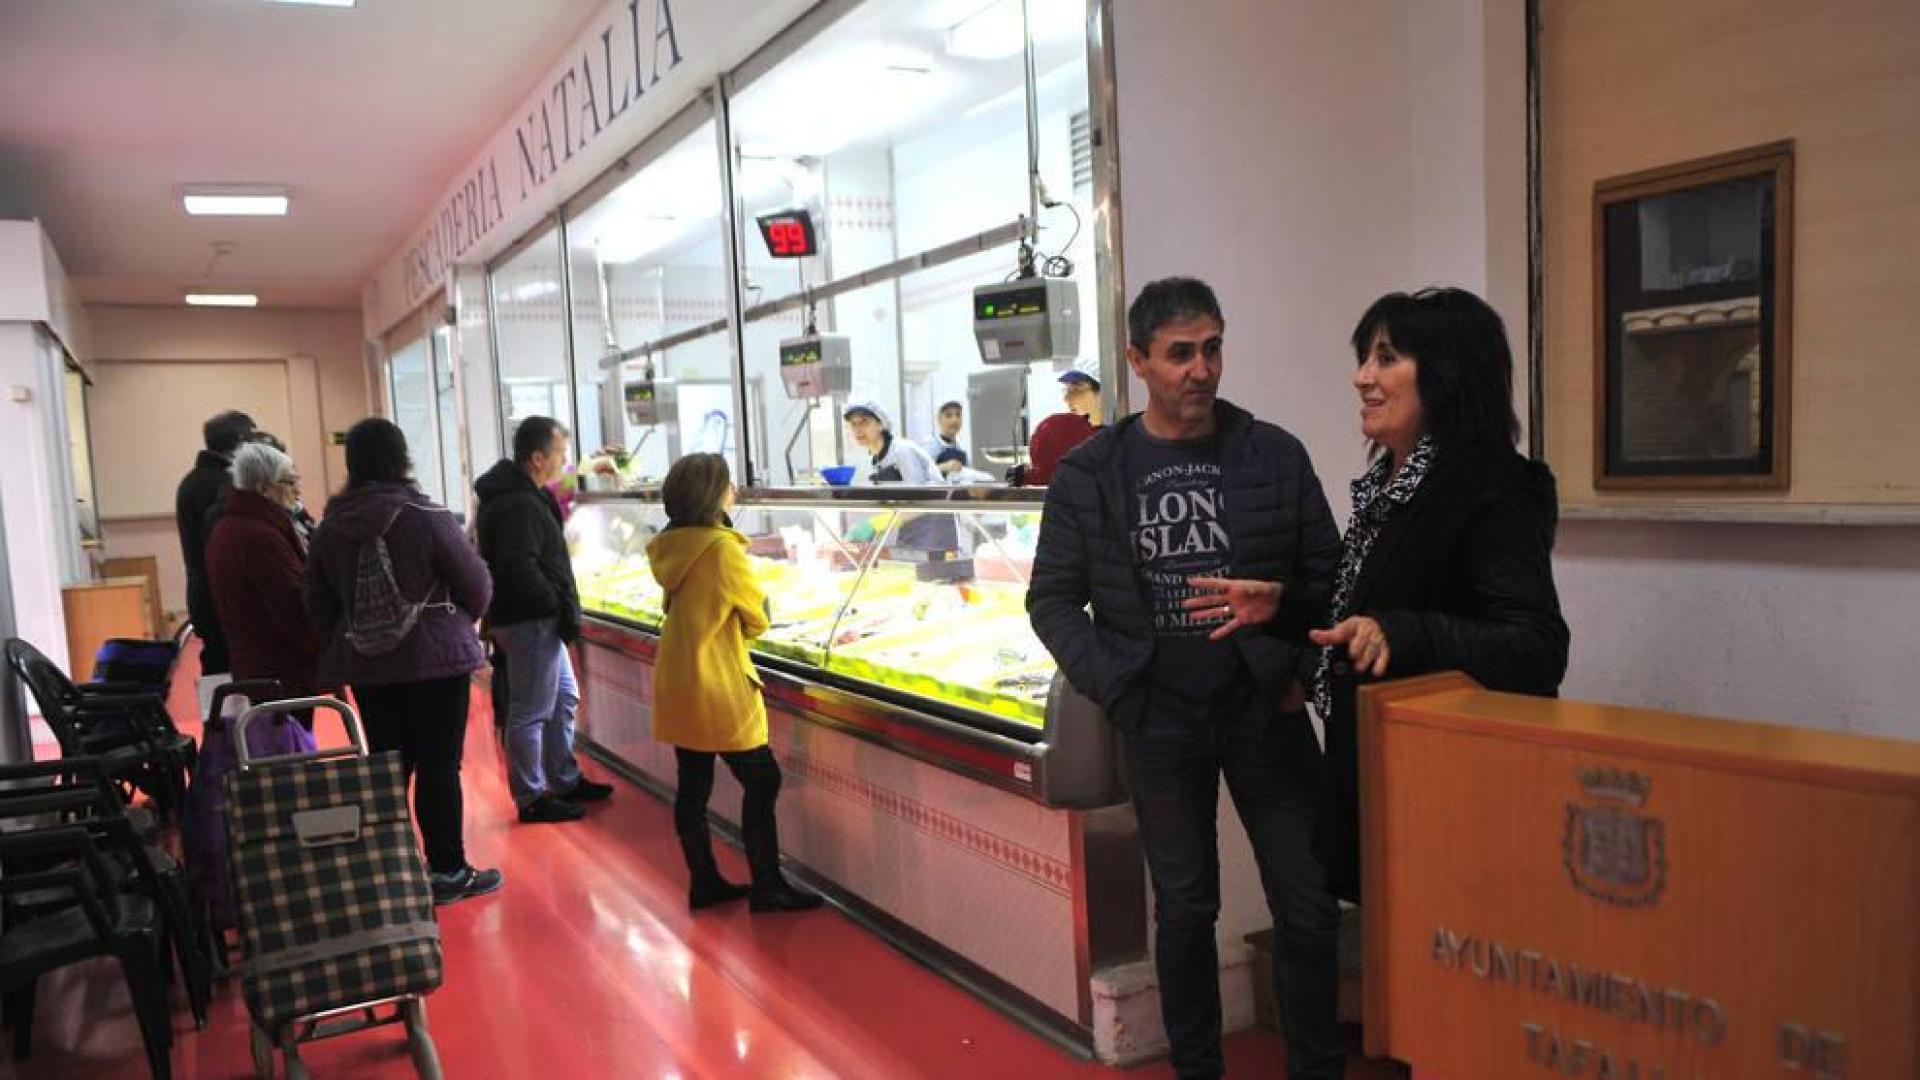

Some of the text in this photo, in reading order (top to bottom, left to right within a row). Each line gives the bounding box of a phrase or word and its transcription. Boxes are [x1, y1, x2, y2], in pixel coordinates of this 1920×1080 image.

[403, 0, 683, 306] PESCADERIA NATALIA
[769, 223, 808, 253] 99
[1432, 926, 1846, 1080] AYUNTAMIENTO DE
[1522, 1022, 1708, 1080] TAFA
